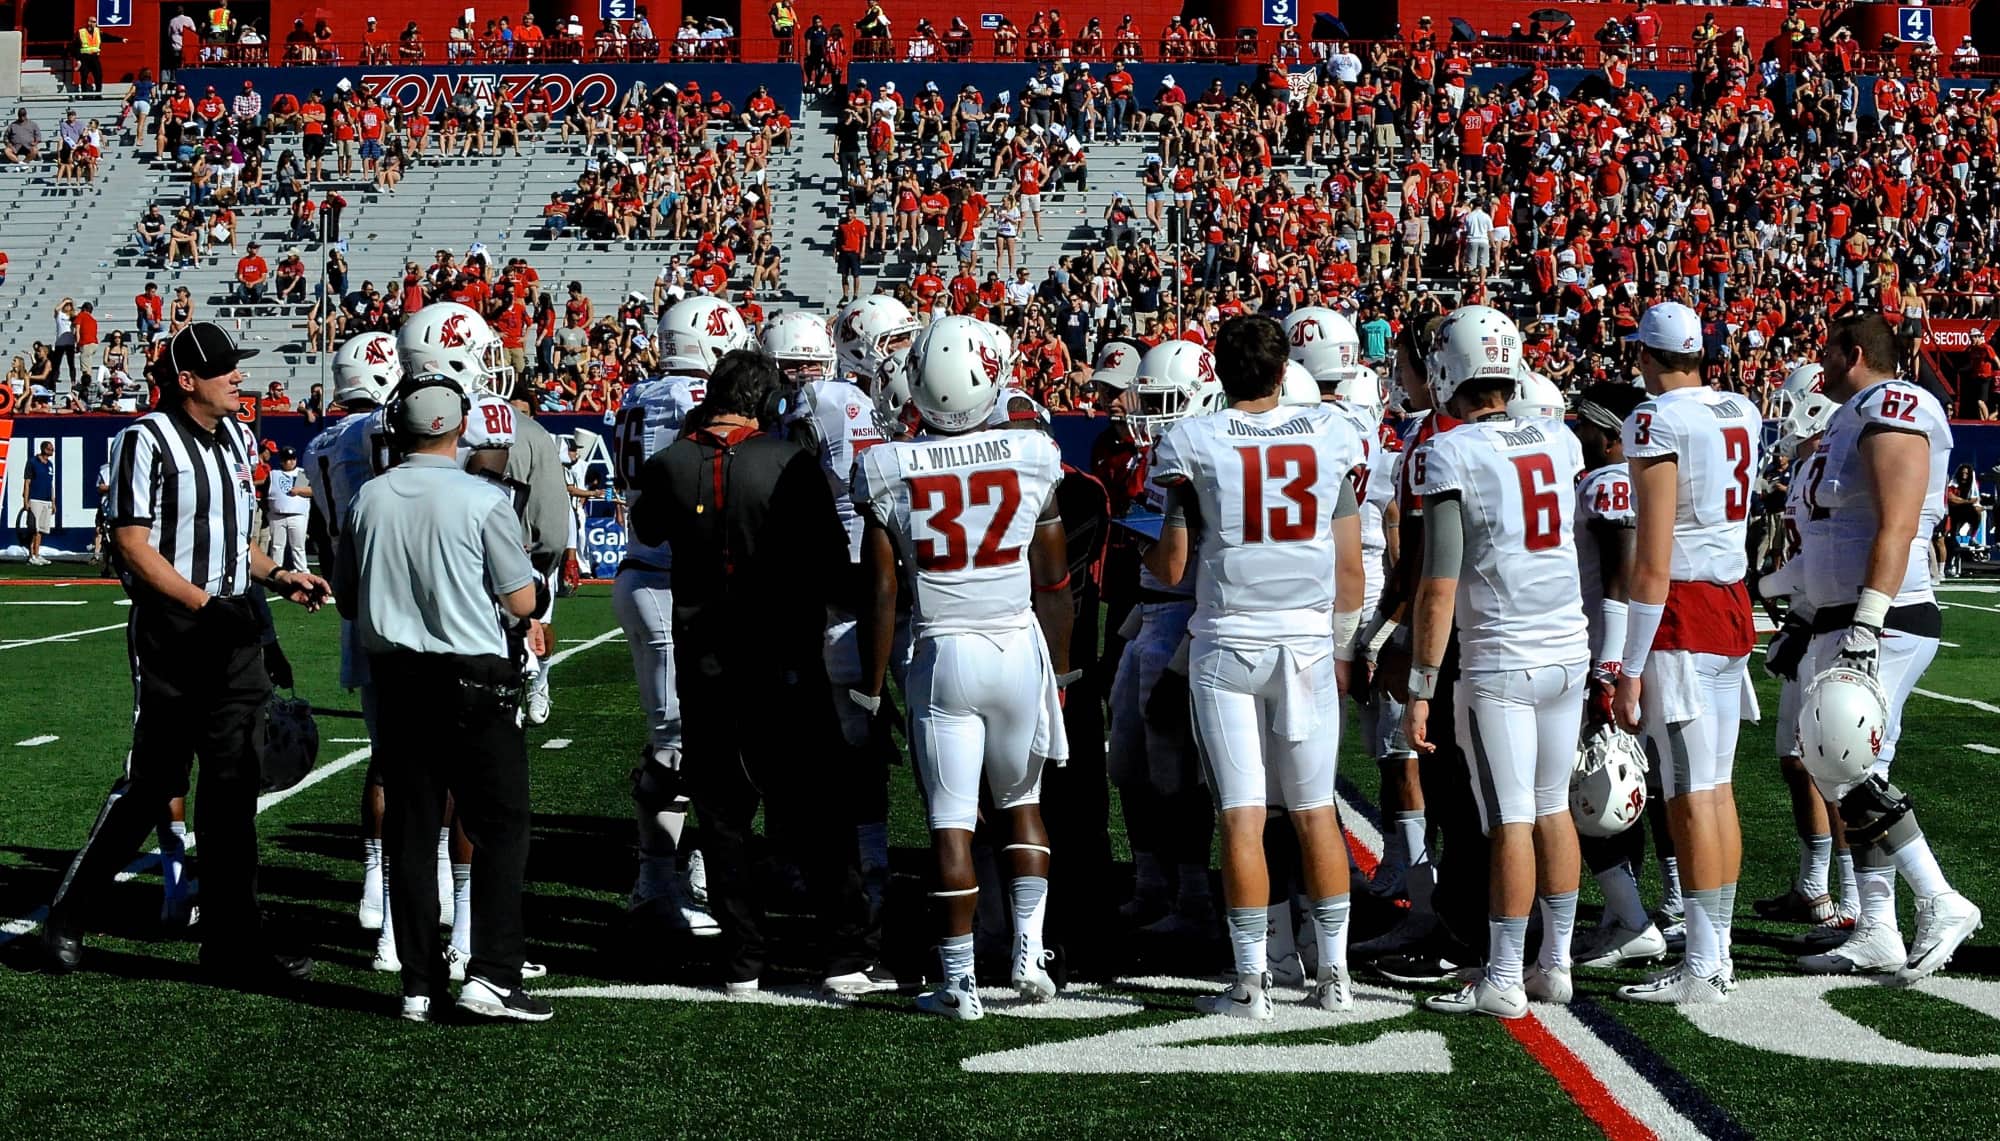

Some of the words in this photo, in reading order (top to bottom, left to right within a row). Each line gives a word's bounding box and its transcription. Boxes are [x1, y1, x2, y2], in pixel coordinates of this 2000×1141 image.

[1907, 10, 1924, 30] 4
[1934, 331, 1971, 345] SECTIO
[1501, 347, 1509, 363] 6
[479, 404, 513, 434] 80
[1880, 389, 1919, 423] 62
[1227, 416, 1315, 437] JORGENSON
[1634, 412, 1652, 445] 3
[909, 449, 924, 471] J.
[926, 439, 1012, 470] WILLIAMS
[1413, 452, 1427, 486] 6
[1719, 426, 1751, 522] 3
[1233, 443, 1319, 544] 13
[1508, 452, 1562, 553] 6
[1593, 481, 1630, 512] 48
[905, 468, 1022, 573] 32
